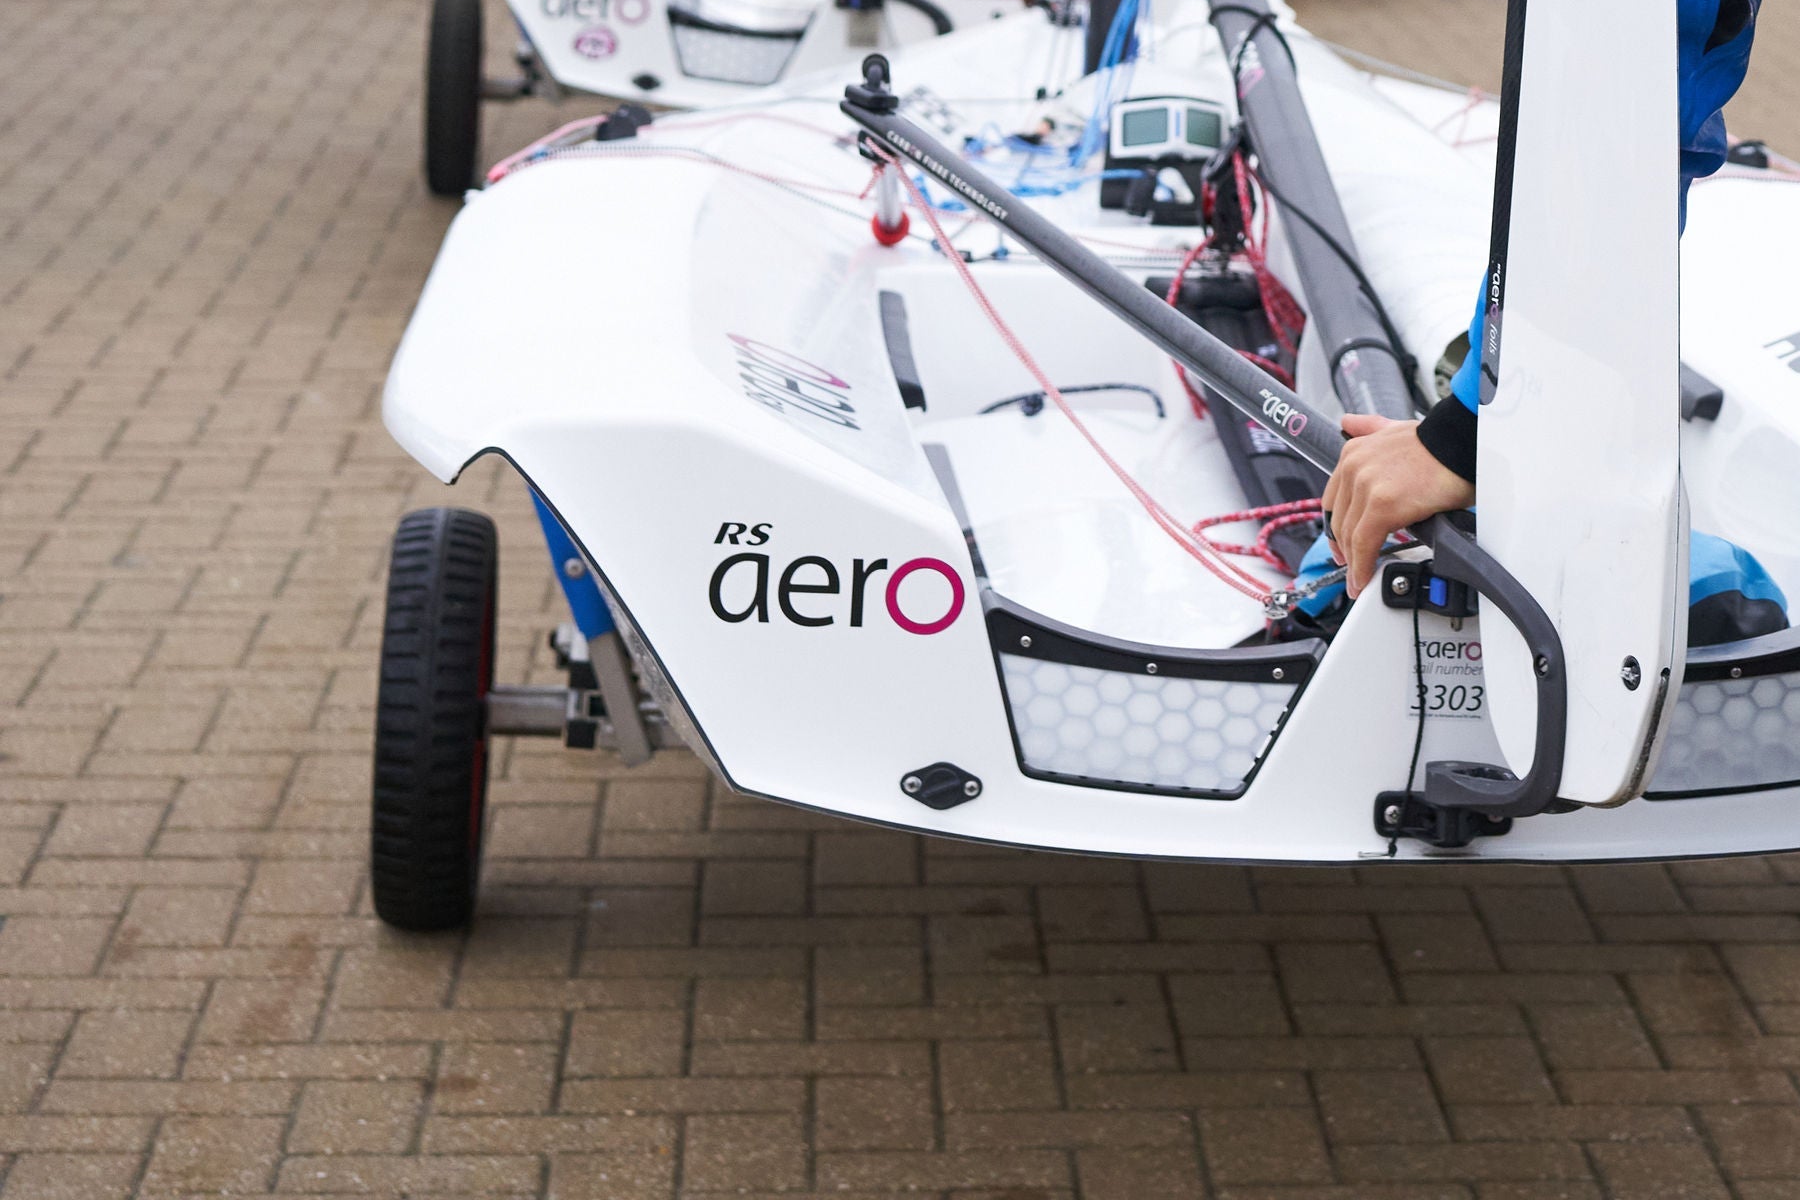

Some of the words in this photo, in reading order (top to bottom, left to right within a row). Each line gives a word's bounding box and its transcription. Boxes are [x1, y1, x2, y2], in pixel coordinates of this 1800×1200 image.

[949, 172, 1008, 220] TECHNOLOGY
[1262, 396, 1308, 437] aero
[713, 522, 773, 546] RS
[708, 552, 965, 635] aero
[1426, 641, 1482, 662] aero
[1410, 684, 1484, 711] 3303
